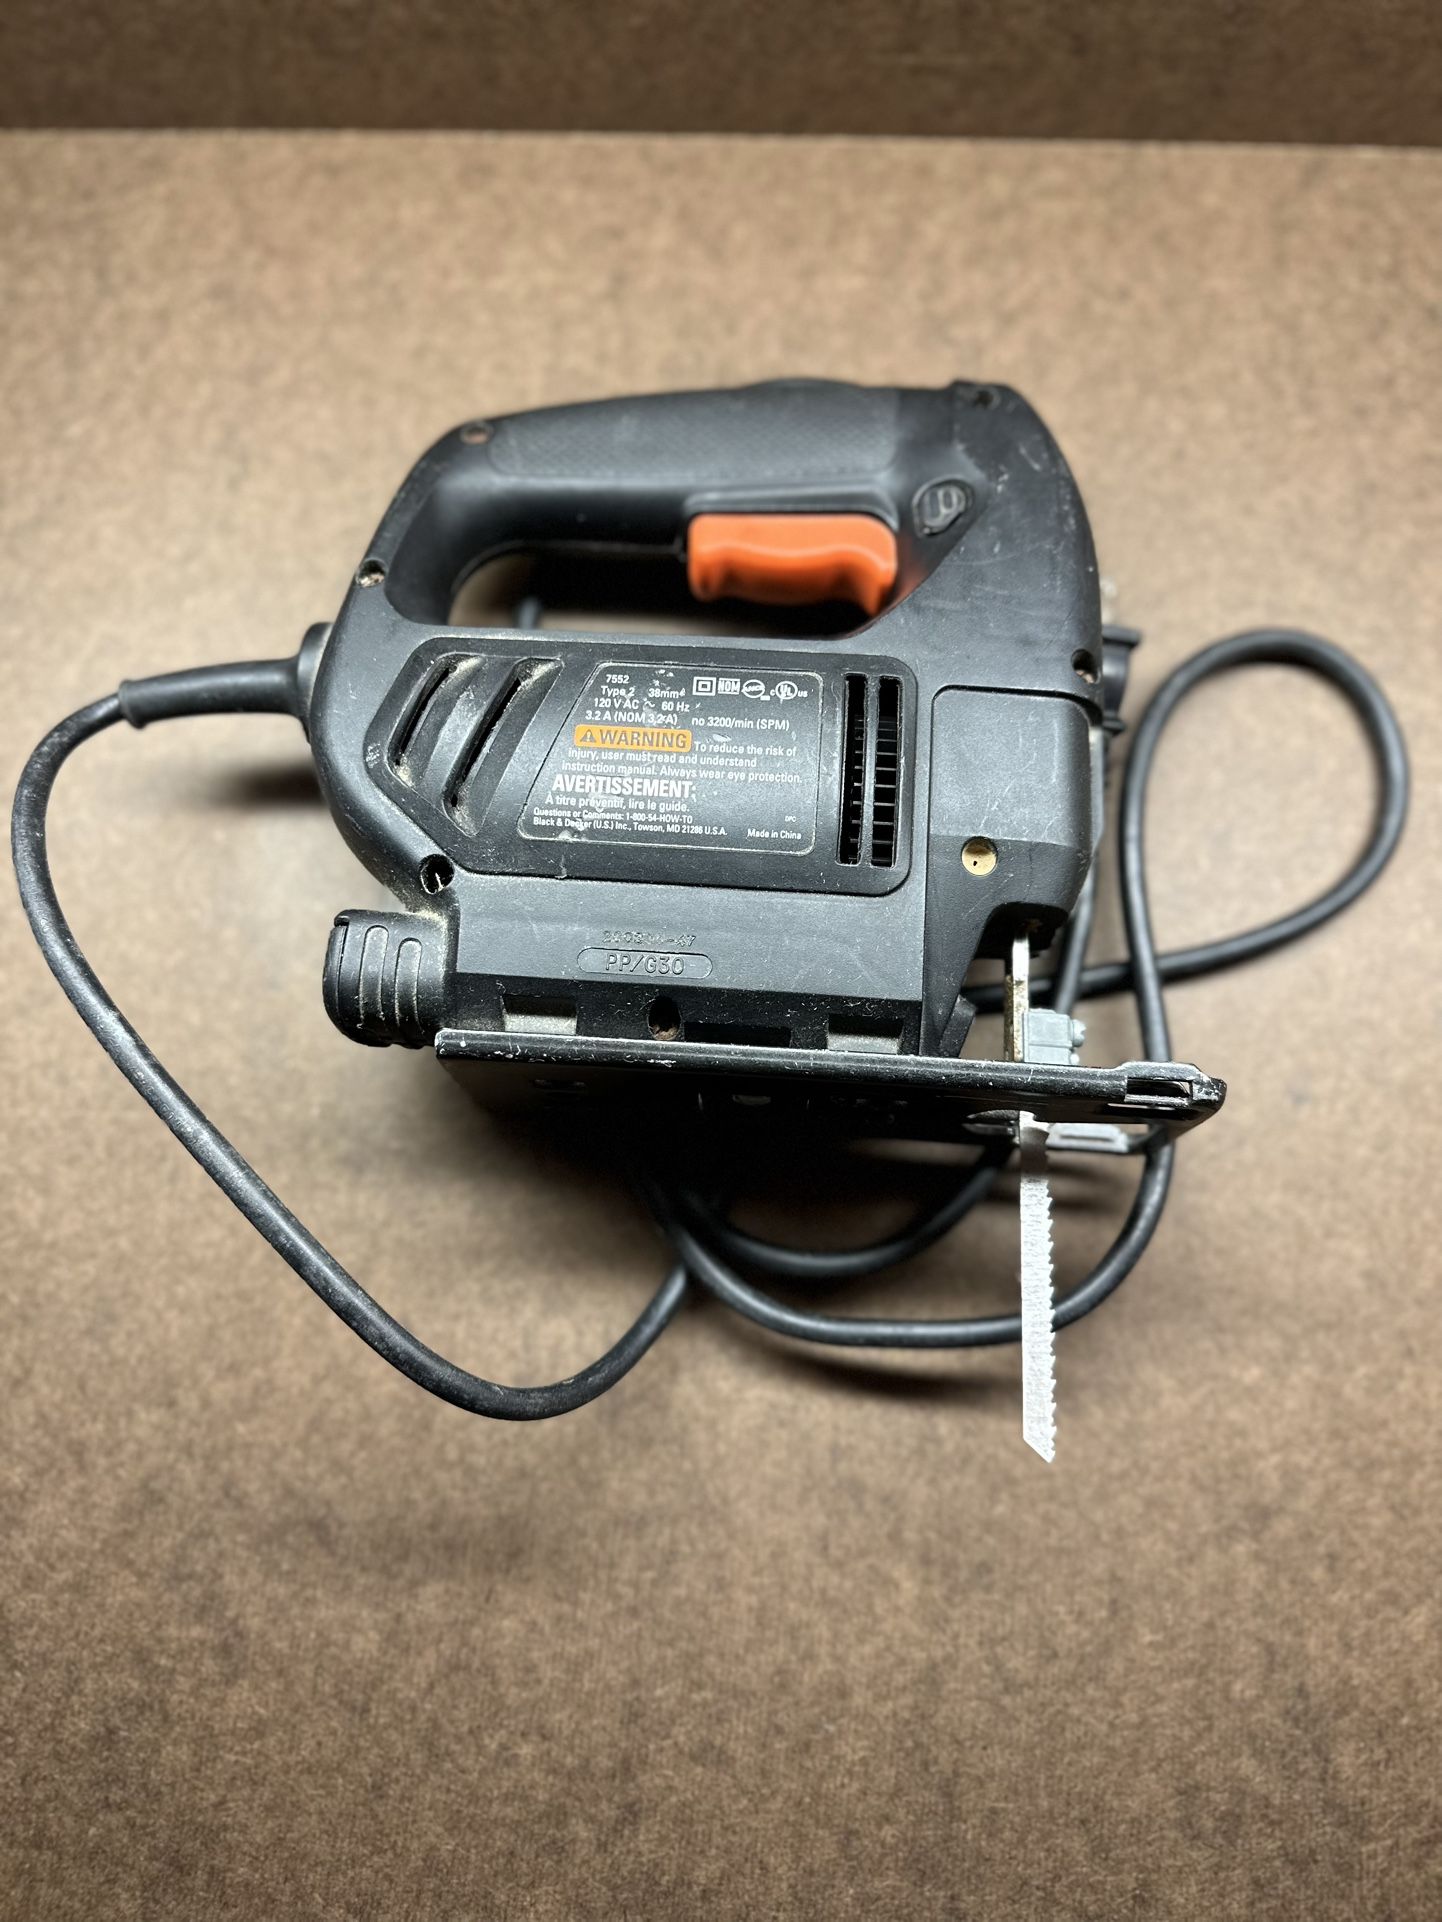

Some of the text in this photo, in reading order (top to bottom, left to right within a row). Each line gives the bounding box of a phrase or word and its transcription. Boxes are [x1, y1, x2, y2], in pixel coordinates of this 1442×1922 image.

[605, 674, 630, 684] 7552
[717, 679, 740, 693] NOM
[601, 685, 626, 697] Type
[628, 686, 636, 697] 2
[594, 697, 612, 708] 120
[613, 698, 622, 709] V
[622, 699, 640, 710] AC
[661, 701, 674, 711] 60
[676, 702, 690, 712] Hz
[585, 710, 601, 721] 3.2
[602, 711, 612, 721] A
[613, 711, 646, 723] (NOM
[707, 716, 754, 729] 3200/min
[756, 718, 790, 731] (SPM)
[599, 729, 687, 749] WARNING
[694, 741, 797, 757] To reduce the risk of
[568, 748, 757, 768] injury, user must read and understand
[562, 761, 802, 783] instruction manual. Always wear eye protection.
[552, 774, 697, 799] AVERTISSEMENT:
[556, 794, 576, 806] titre
[628, 798, 644, 809] lire
[647, 799, 657, 810] le
[659, 800, 690, 813] guide.
[533, 807, 693, 824] Questions or Comments: 1-800-54-HOW-TO
[533, 817, 555, 826] Black
[555, 818, 563, 827] &
[593, 820, 614, 830] (U.S.)
[615, 822, 632, 832] Inc.,
[634, 823, 665, 833] Towson,
[666, 824, 680, 833] MD
[681, 825, 703, 835] 21286
[704, 826, 728, 836] U.S.A.
[747, 828, 802, 840] Made in China
[605, 952, 685, 976] PP/G30
